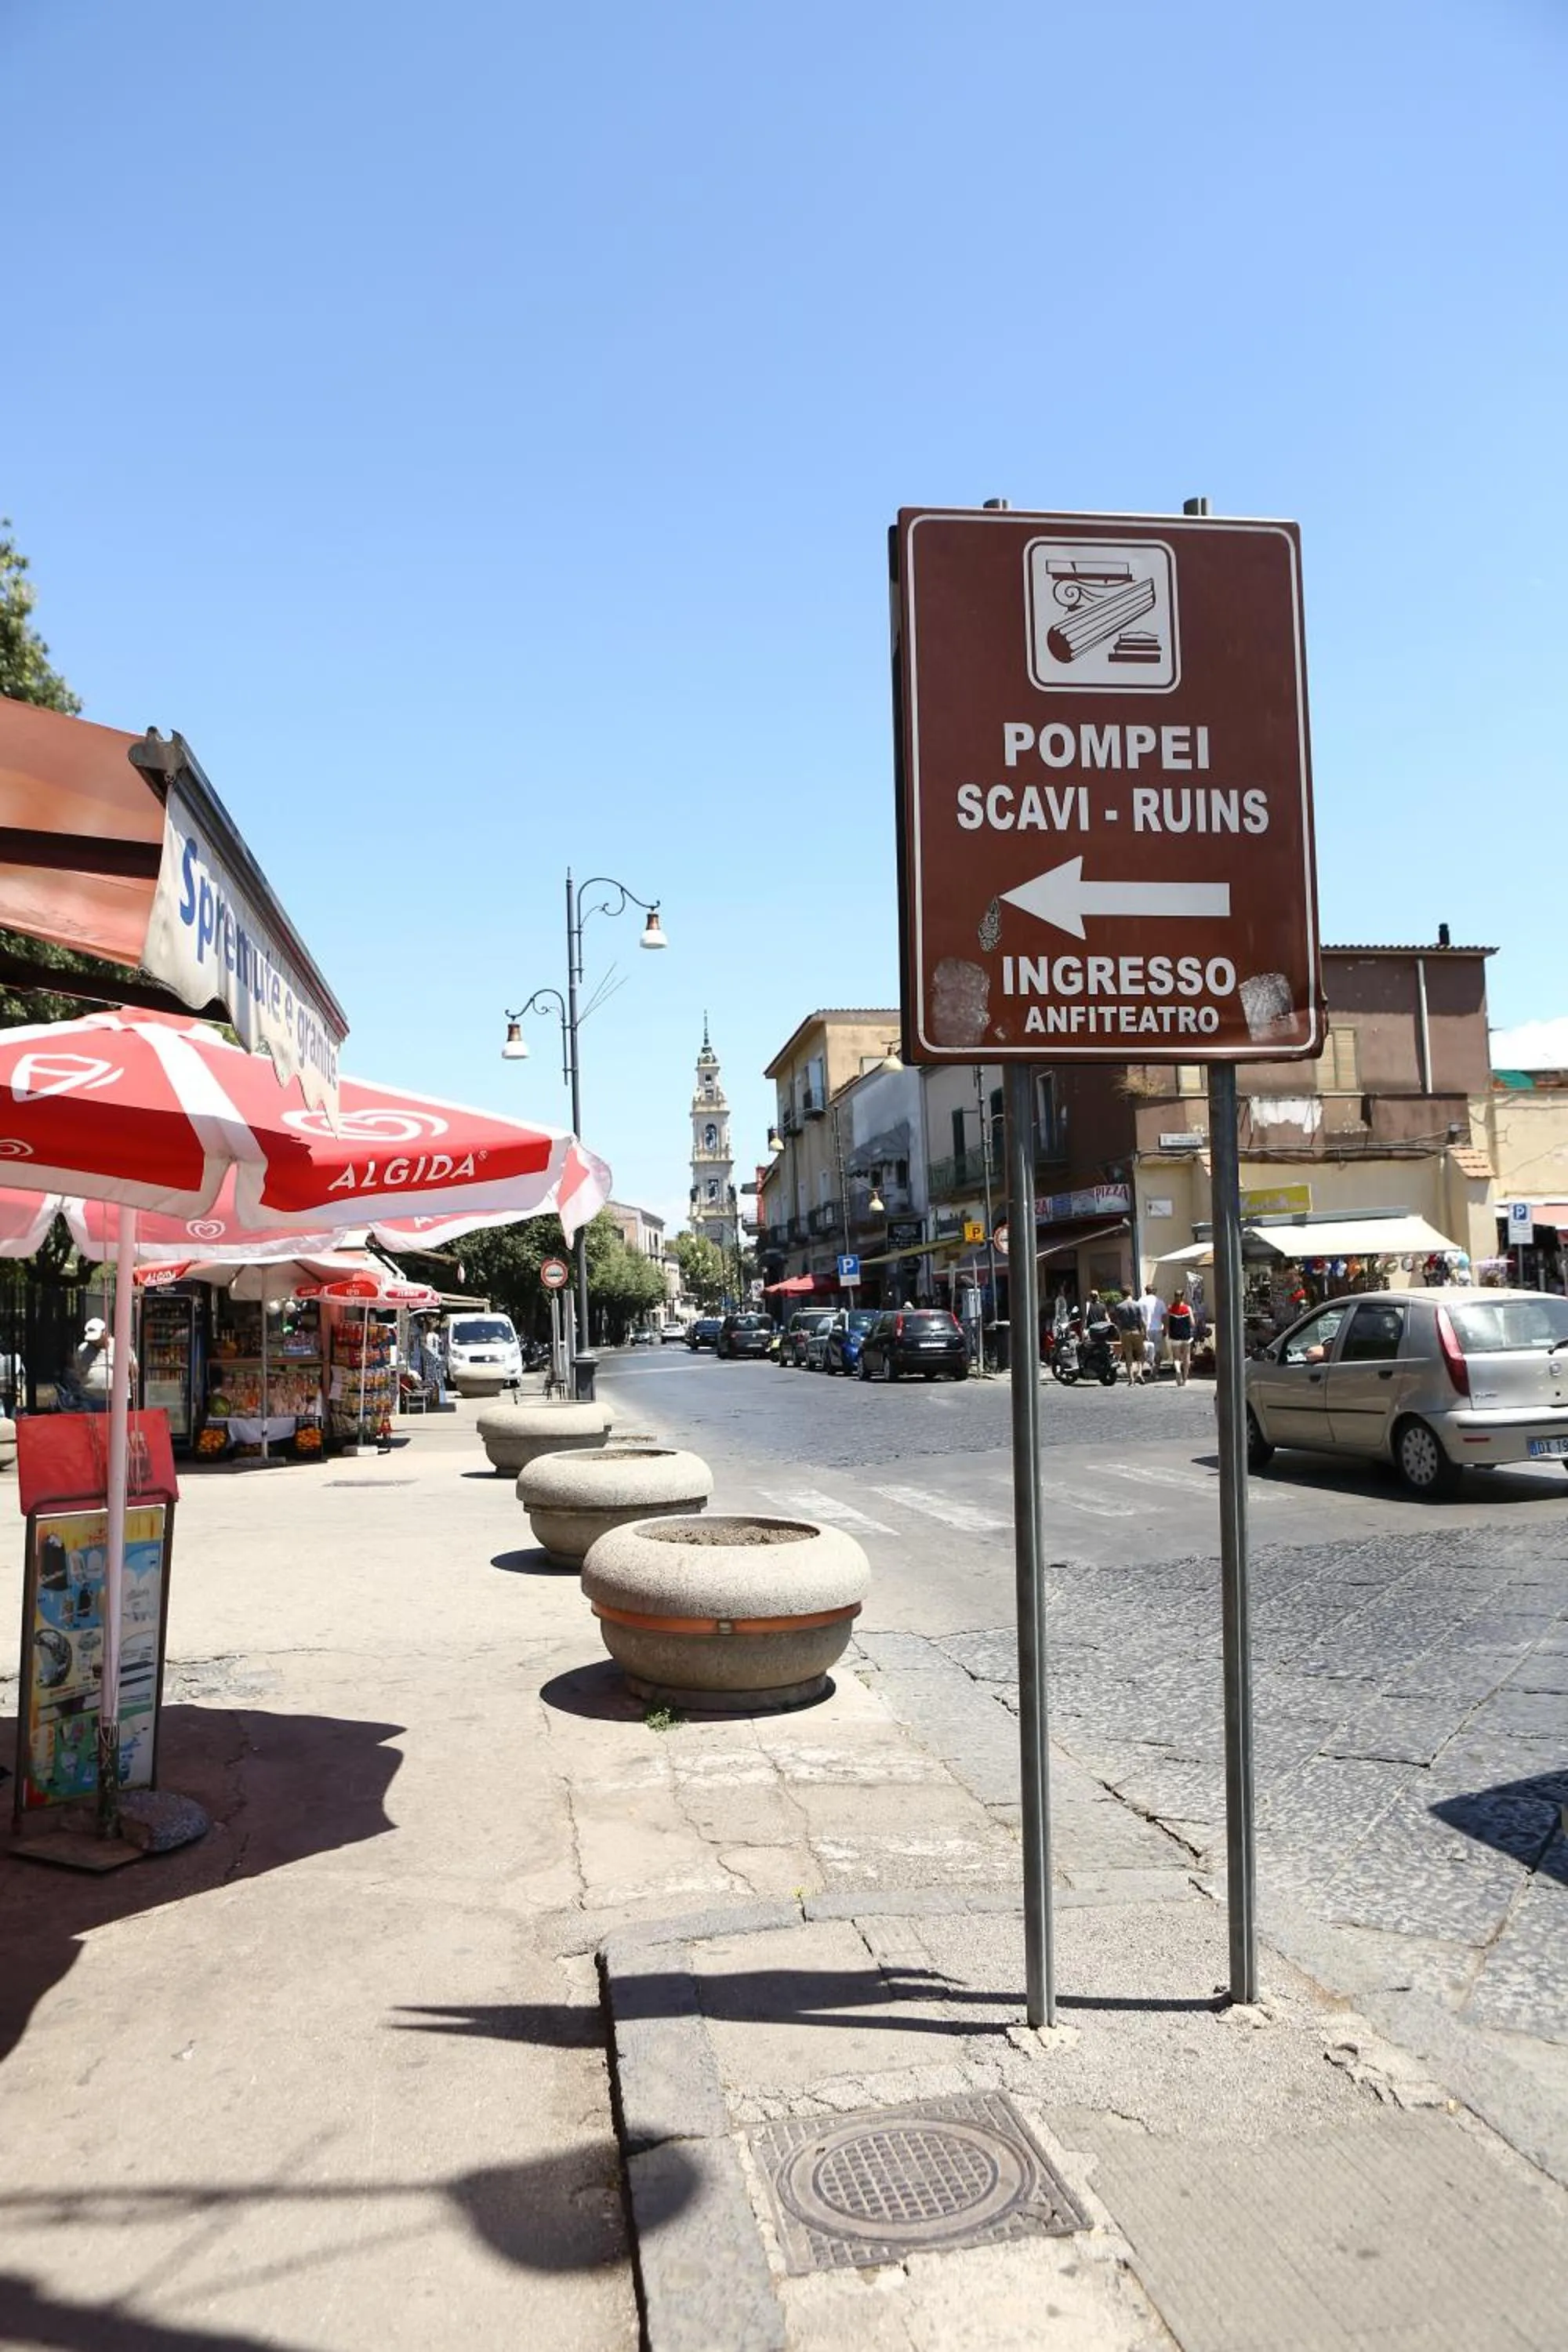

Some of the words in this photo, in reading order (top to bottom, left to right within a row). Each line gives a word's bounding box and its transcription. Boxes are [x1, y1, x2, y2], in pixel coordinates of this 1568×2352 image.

[1004, 723, 1209, 769] POMPEI
[957, 784, 1089, 830] SCAVI
[1134, 788, 1269, 833] RUINS
[180, 837, 281, 1022] Spremute
[297, 1004, 337, 1091] granite
[1004, 956, 1236, 996] INGRESSO
[1025, 1007, 1218, 1032] ANFITEATRO
[1095, 1185, 1129, 1204] PIZZA
[1516, 1207, 1525, 1219] P
[972, 1227, 981, 1238] P
[842, 1258, 854, 1274] P
